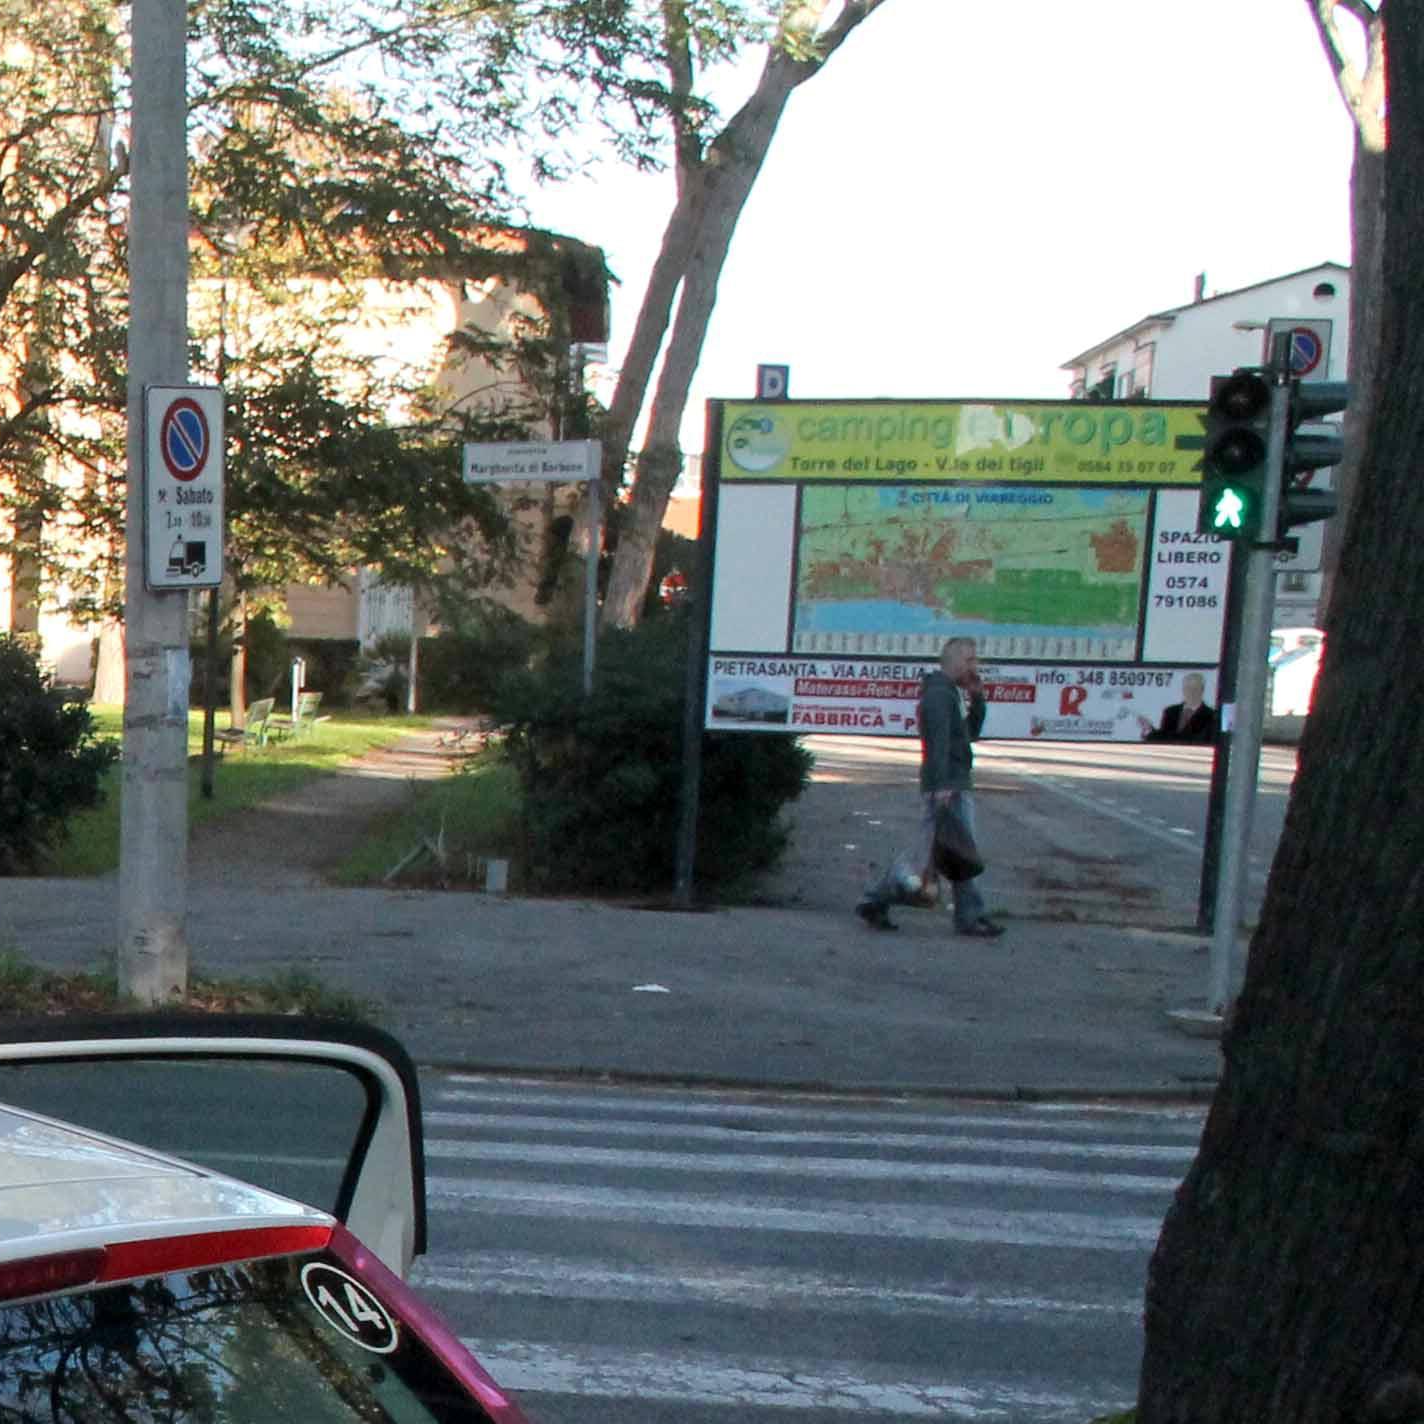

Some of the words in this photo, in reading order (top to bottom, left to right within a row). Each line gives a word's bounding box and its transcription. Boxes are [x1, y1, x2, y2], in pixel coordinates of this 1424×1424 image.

[798, 408, 953, 449] camping
[791, 456, 837, 472] Torre
[841, 456, 869, 472] del
[875, 456, 917, 474] Lago
[175, 486, 214, 504] Sabato
[1159, 531, 1221, 544] SPAZIO
[1157, 551, 1221, 564] LIBERO
[1166, 576, 1209, 589] 0574
[1154, 595, 1217, 608] 791086
[713, 660, 817, 679] PIETRASANTA
[831, 664, 860, 678] VIA
[861, 665, 927, 681] AURELIA
[1076, 671, 1105, 685] 348
[1108, 672, 1174, 687] 8509767
[792, 711, 884, 728] FABBRICA
[317, 1282, 386, 1332] 14
